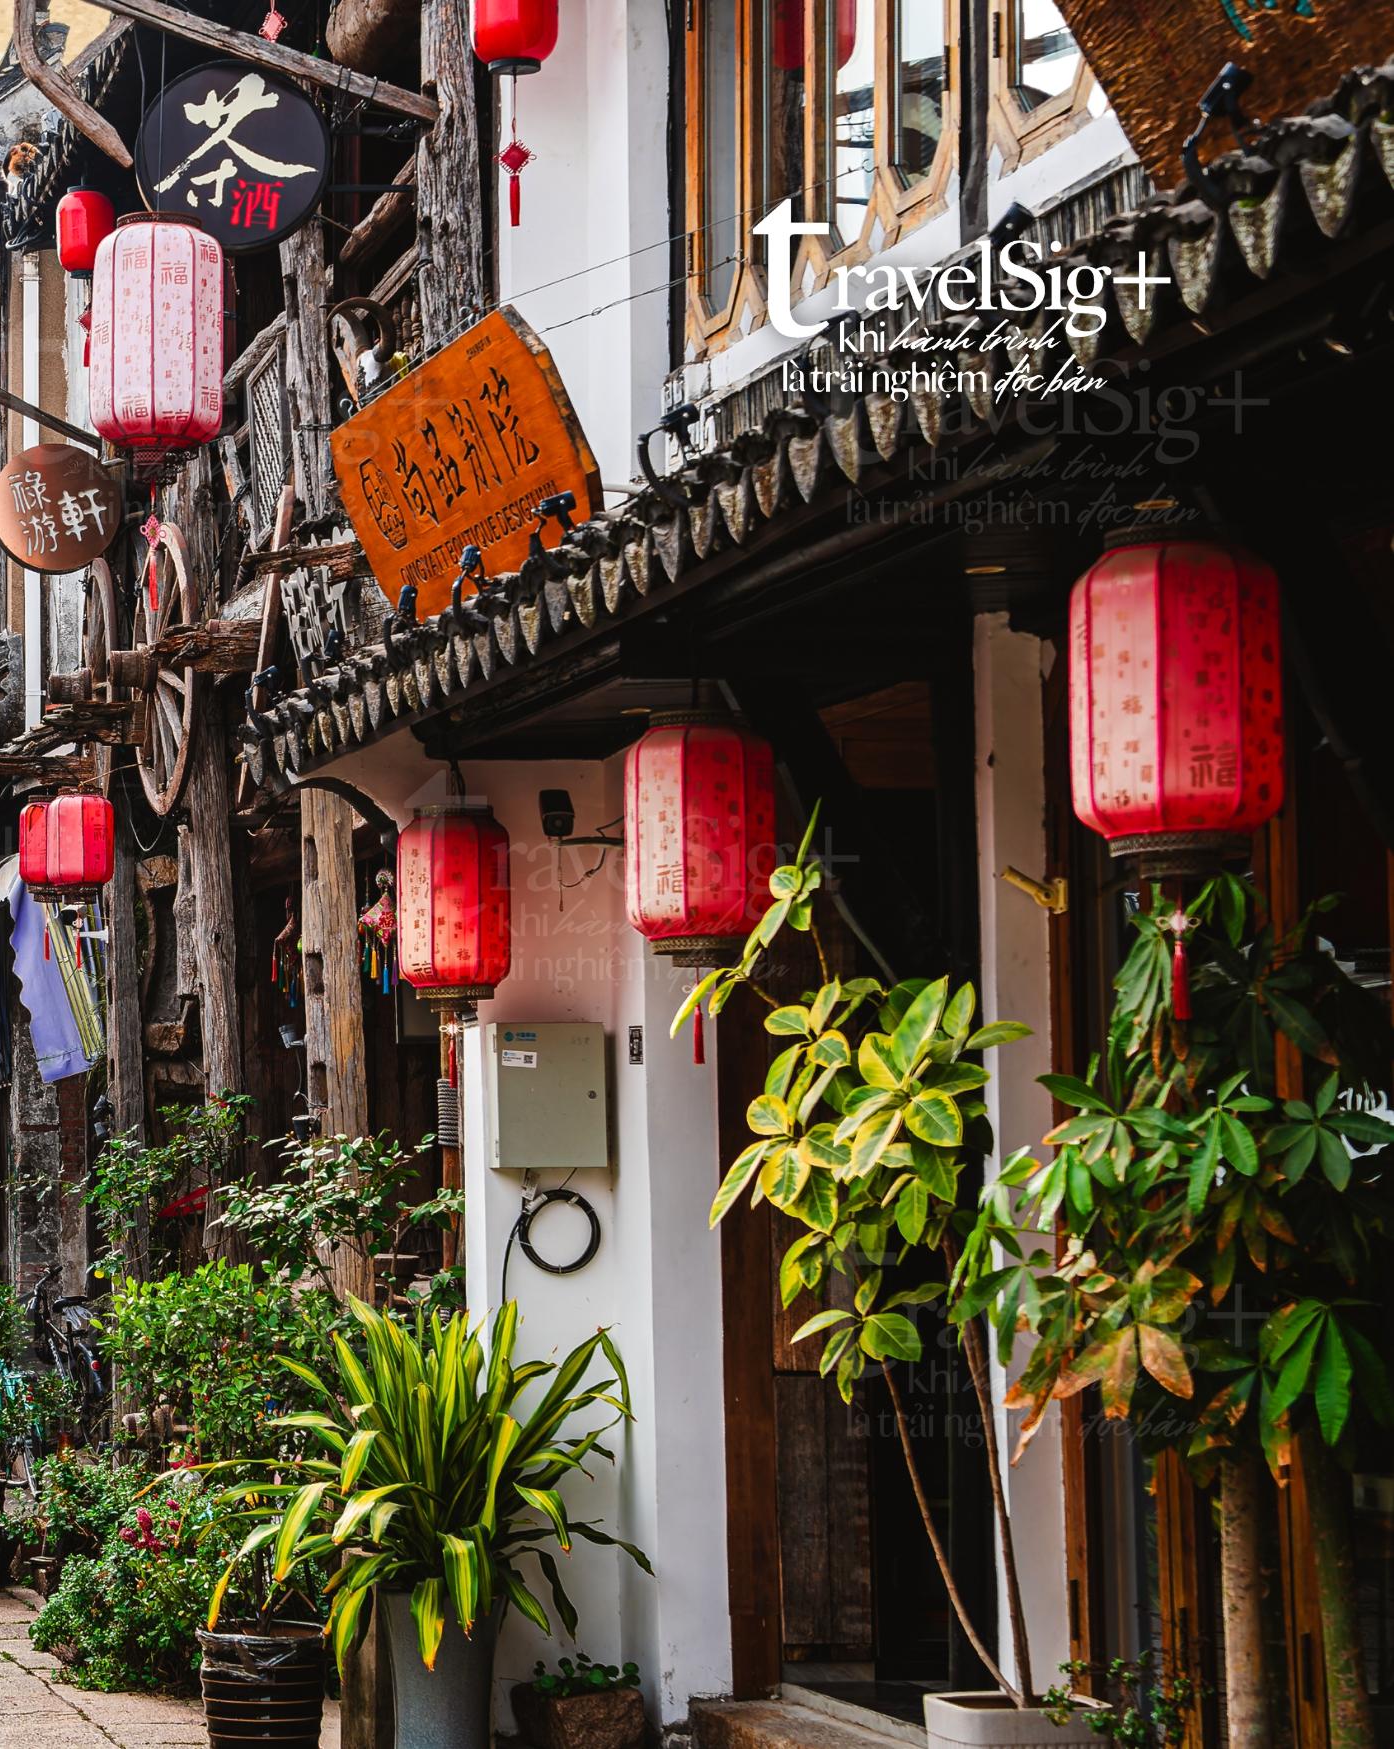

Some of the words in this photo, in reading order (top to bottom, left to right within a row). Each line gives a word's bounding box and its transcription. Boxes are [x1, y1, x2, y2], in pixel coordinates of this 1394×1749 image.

[155, 74, 317, 208] 茶
[231, 180, 282, 231] 酒
[123, 245, 148, 270] 福
[161, 260, 188, 286] 福
[122, 393, 148, 420] 福
[1189, 740, 1237, 788] 福
